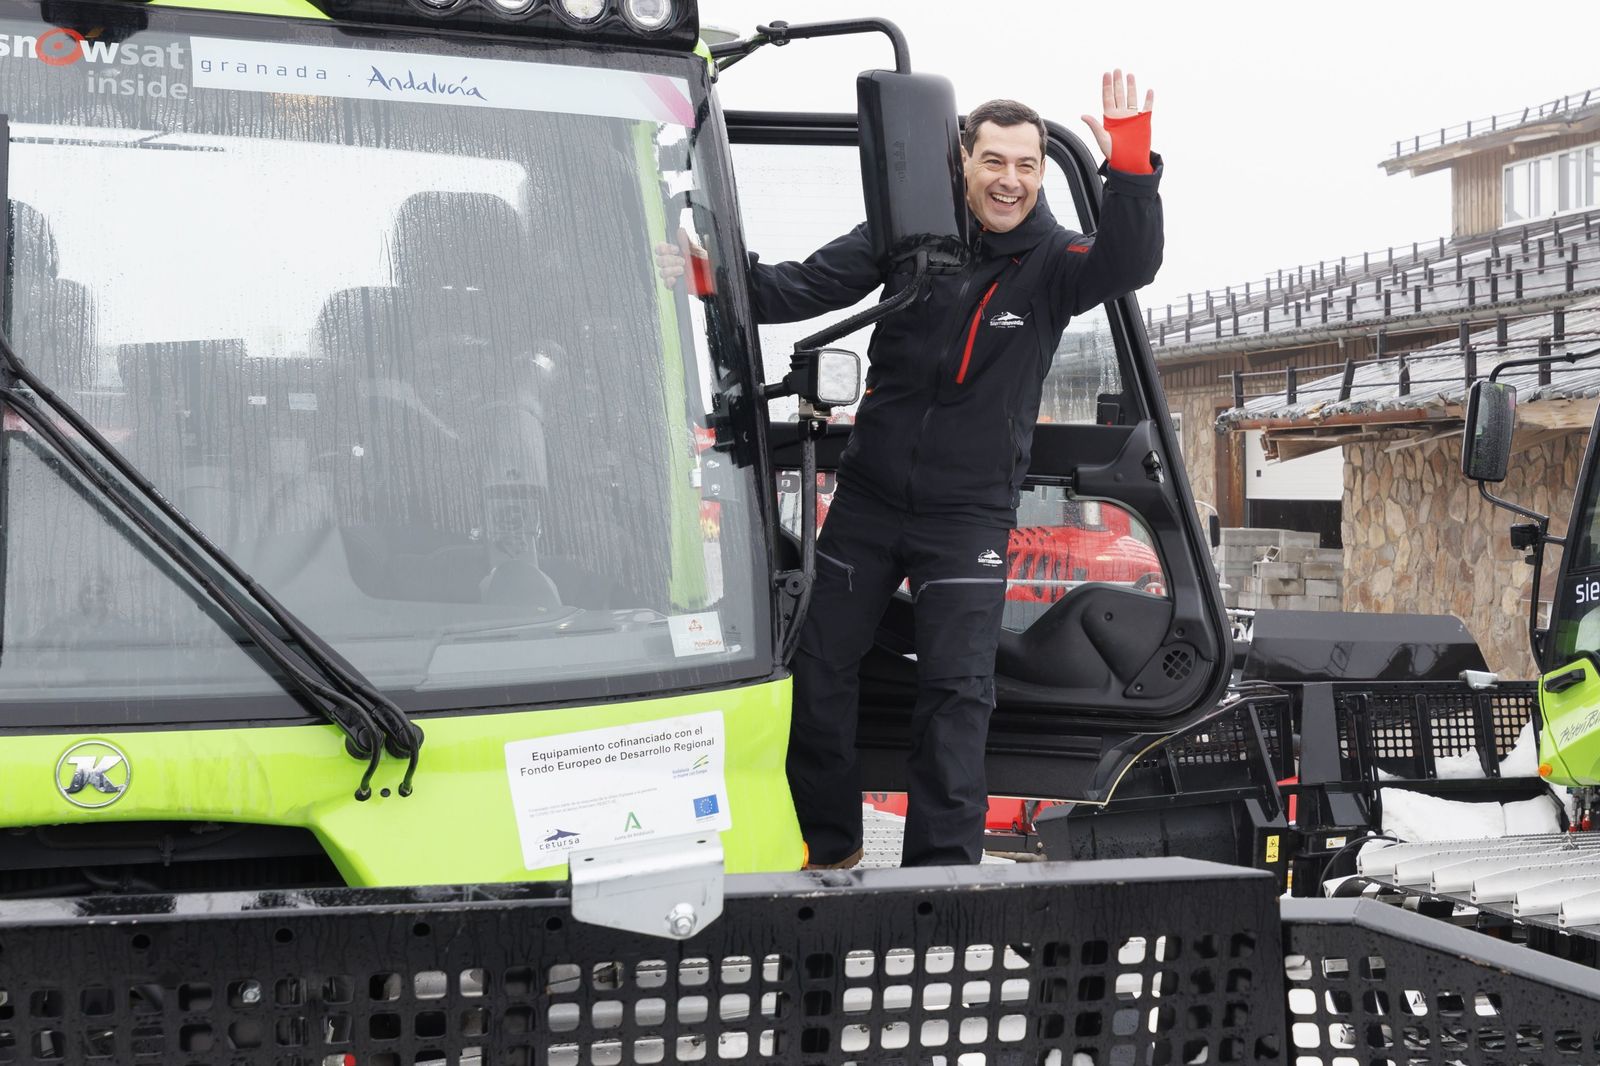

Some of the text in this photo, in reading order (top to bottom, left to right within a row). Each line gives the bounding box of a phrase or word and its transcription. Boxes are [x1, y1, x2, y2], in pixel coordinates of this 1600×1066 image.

[87, 70, 188, 100] inside
[200, 59, 488, 101] granada Andalucía
[521, 737, 715, 776] Fondo Europeo de Desarrollo Regional
[532, 726, 703, 761] Equipamiento cofinanciado con el
[539, 837, 581, 851] cetursa
